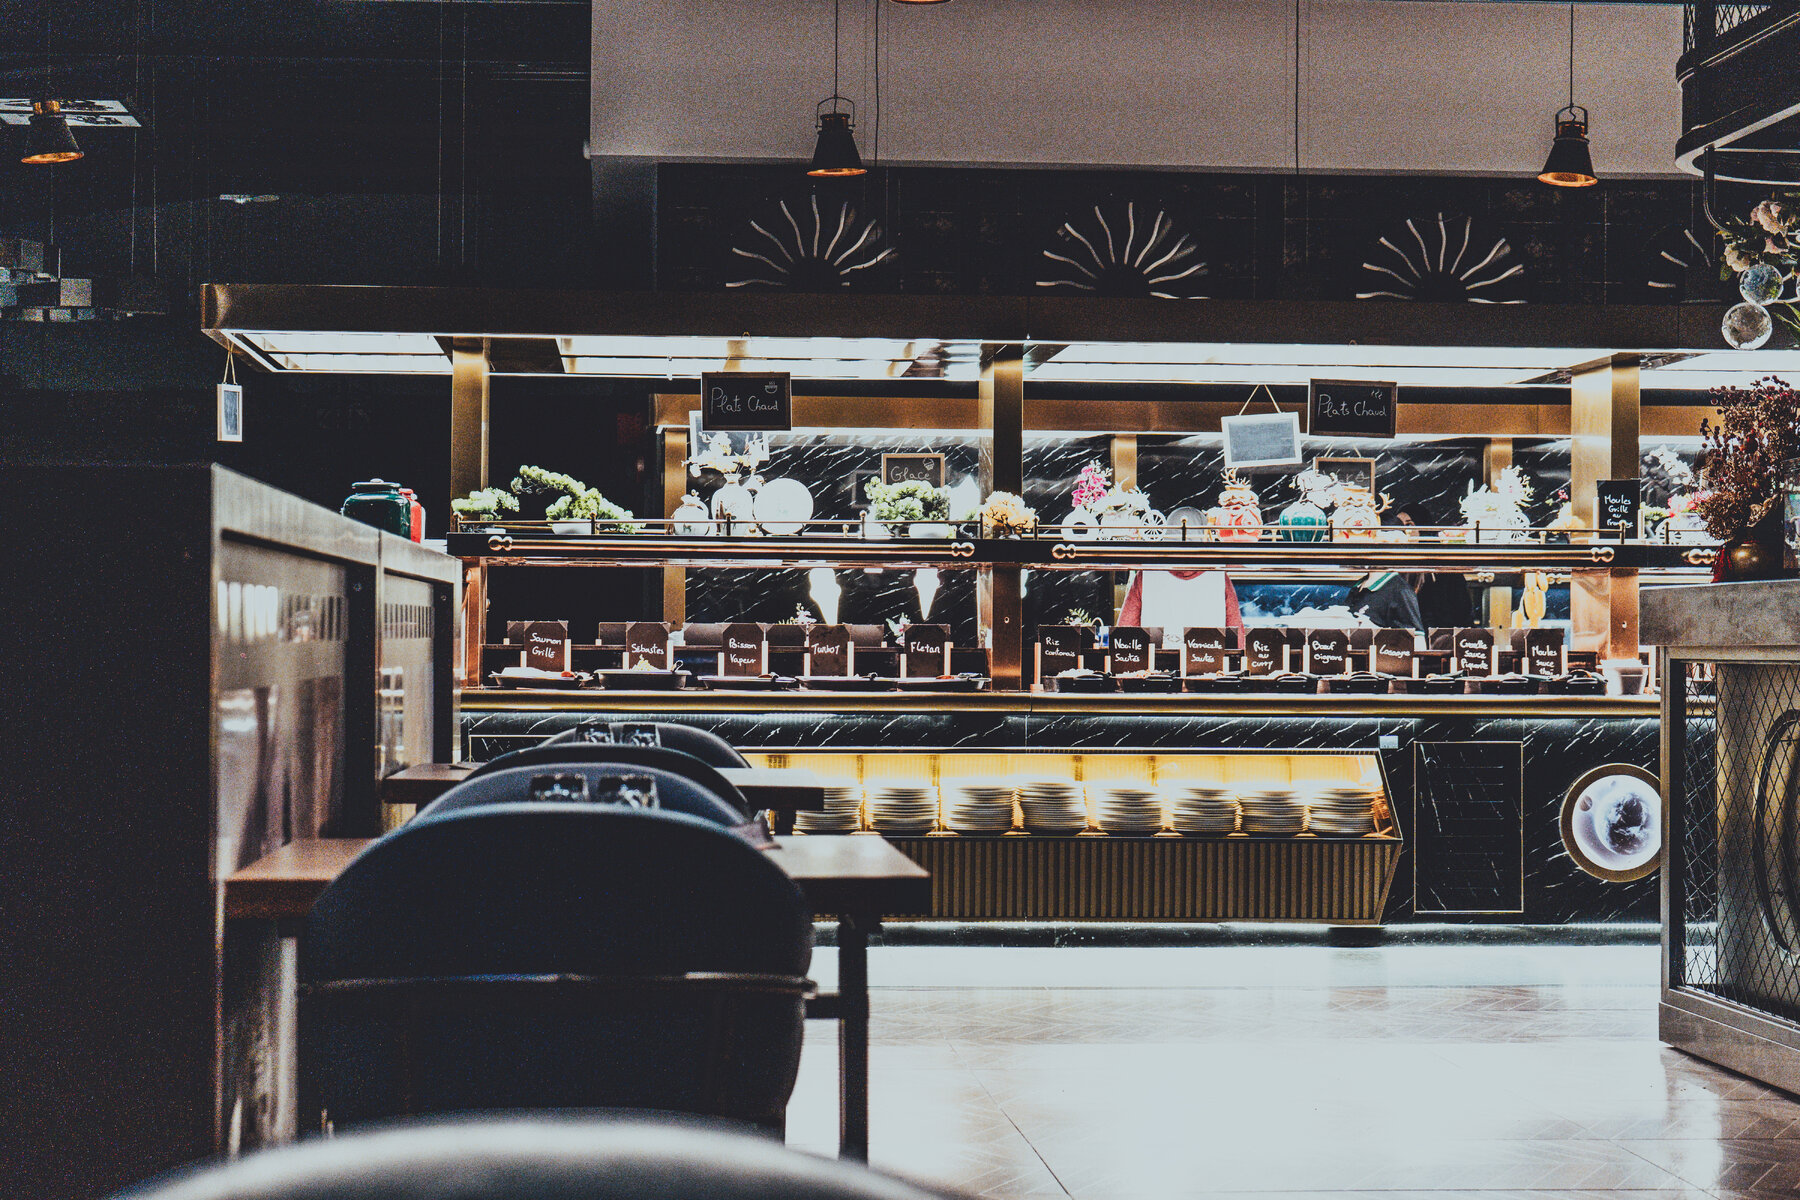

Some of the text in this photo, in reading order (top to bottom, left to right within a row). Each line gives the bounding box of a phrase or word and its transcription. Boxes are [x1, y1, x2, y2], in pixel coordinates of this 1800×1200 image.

[710, 387, 779, 415] Plats Chaud
[1317, 393, 1387, 417] Plats Chaud
[890, 465, 931, 481] Glace
[529, 632, 562, 646] Saumon
[728, 637, 757, 650] Poisson
[1045, 636, 1060, 646] Riz
[1113, 638, 1142, 651] Nouille
[1252, 640, 1271, 652] Riz
[1531, 644, 1558, 657] Moules
